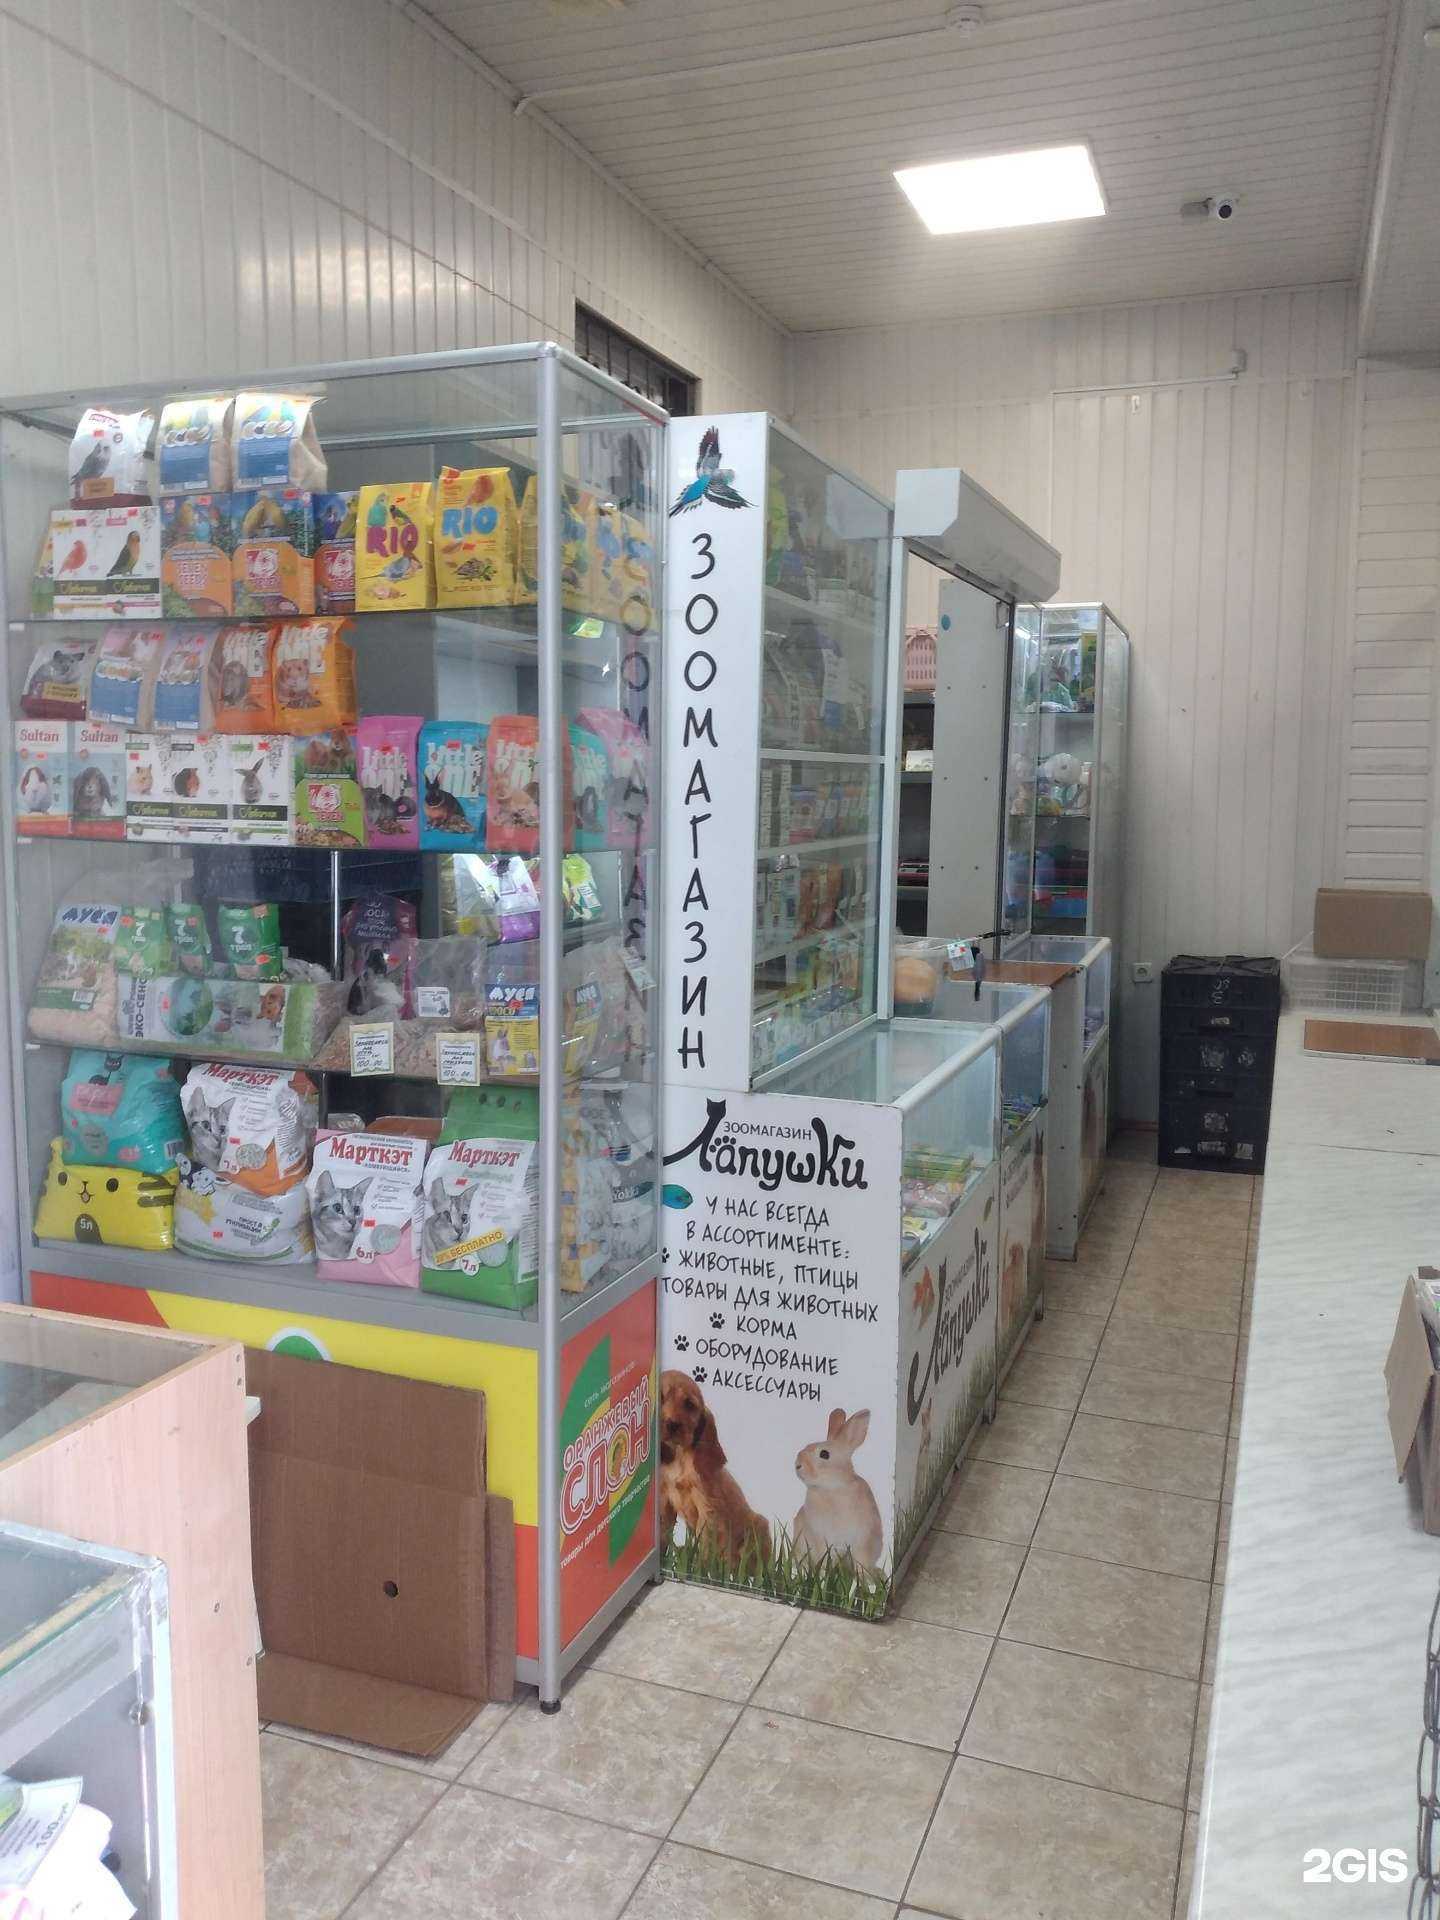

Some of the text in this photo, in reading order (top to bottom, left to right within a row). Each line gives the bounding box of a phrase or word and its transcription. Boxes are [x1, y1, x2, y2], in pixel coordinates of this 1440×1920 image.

[442, 505, 498, 538] RIO
[367, 525, 419, 558] RIO
[20, 729, 59, 742] Sultan
[80, 729, 119, 744] Sultan
[677, 532, 719, 1069] ЗООМАГАЗИН
[135, 921, 145, 937] 7
[175, 919, 186, 937] 7
[231, 926, 244, 944] 7
[203, 1063, 280, 1086] Марткэт
[663, 1098, 869, 1191] Лапушки
[723, 1121, 812, 1141] ЗООМАГАЗИН
[329, 1137, 412, 1166] Марткэт
[448, 1141, 520, 1168] Марткэт
[79, 1217, 93, 1232] 5л
[706, 1196, 830, 1233] У НАС ВСЕГДА
[451, 1231, 504, 1258] БЕСПЛАТНО
[686, 1220, 850, 1259] В АССОРТИМЕНТЕ:
[462, 1259, 477, 1272] 7л
[679, 1249, 858, 1294] ЖИВОТНЫЕ, ПТИЦЫ
[661, 1276, 878, 1322] ТОВАРЫ ДЛЯ ЖИВОТНЫХ
[736, 1315, 797, 1340] КОРМА
[696, 1338, 840, 1376] ОБОРУДОВАНИЕ
[712, 1369, 821, 1402] АКСЕССУАРЫ
[563, 1374, 649, 1472] ОРАНЖЕВЫЙ
[560, 1399, 651, 1536] СЛОН
